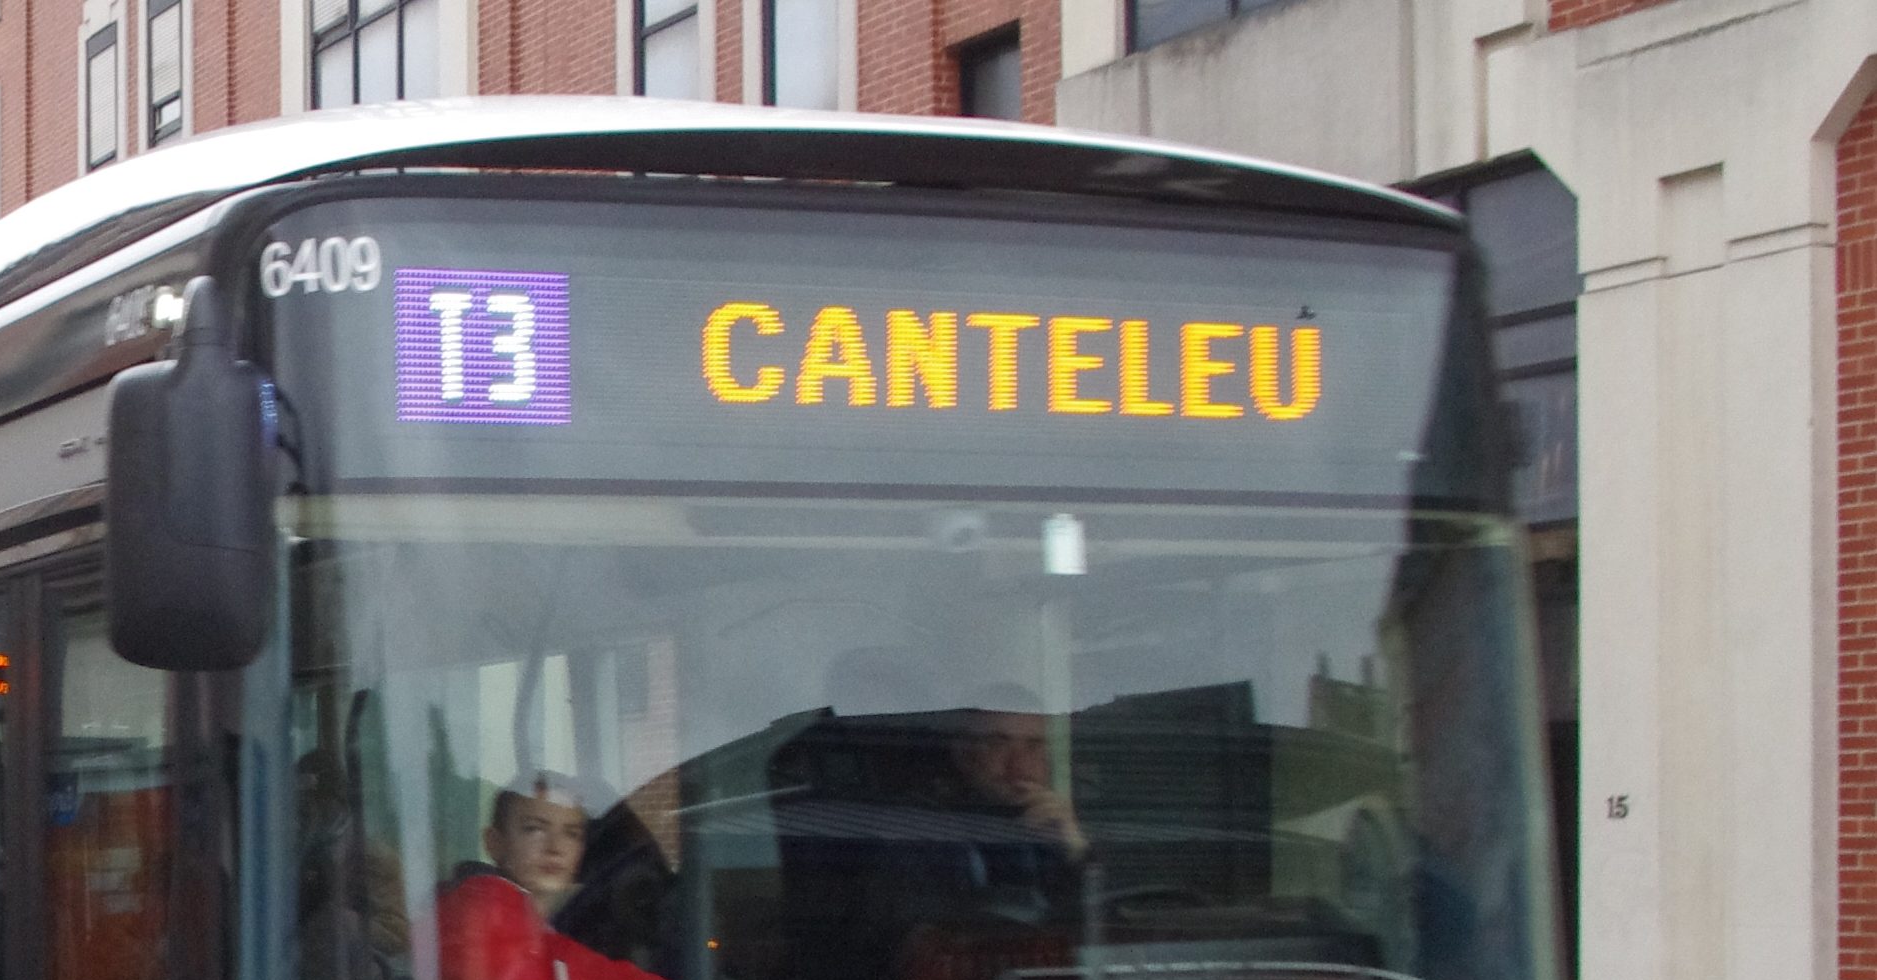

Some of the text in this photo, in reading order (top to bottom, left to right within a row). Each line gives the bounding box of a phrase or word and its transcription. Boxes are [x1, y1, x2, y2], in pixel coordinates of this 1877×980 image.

[260, 236, 382, 298] 6409
[429, 291, 536, 402] T3
[702, 302, 1321, 420] CANTELEU
[1607, 795, 1629, 819] 15
